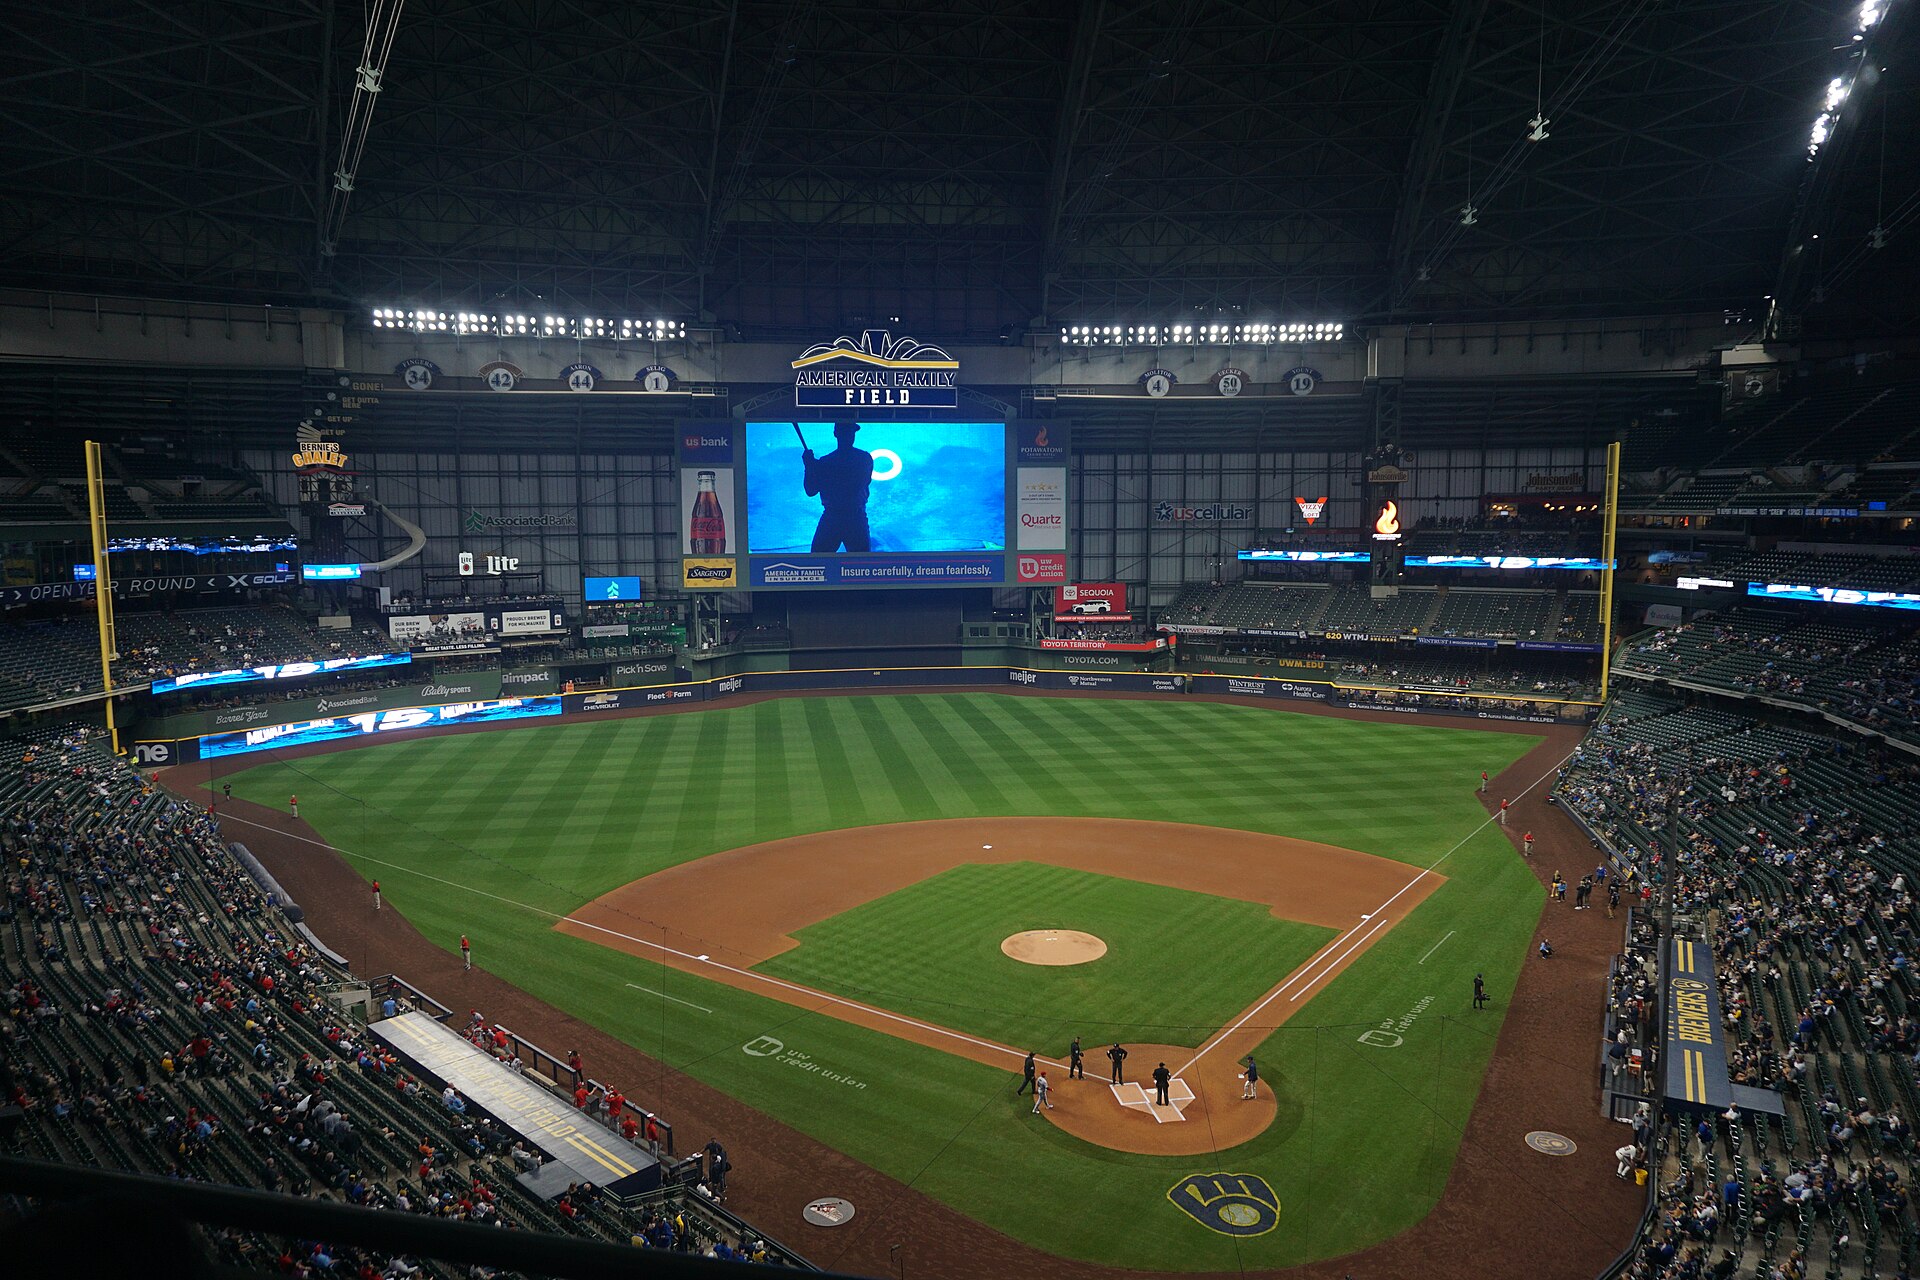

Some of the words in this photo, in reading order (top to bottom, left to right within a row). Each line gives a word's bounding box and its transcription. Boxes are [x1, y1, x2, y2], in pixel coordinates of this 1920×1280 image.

[401, 359, 434, 369] FINGERS
[408, 370, 430, 385] 34
[796, 371, 888, 387] AMERICAN
[894, 371, 956, 387] FAMILY
[1144, 369, 1172, 379] MOLITOR
[1218, 369, 1242, 377] UECKER
[352, 382, 384, 391] GONE!
[491, 373, 511, 387] 42
[571, 374, 592, 389] 44
[652, 376, 662, 390] 1
[1152, 379, 1162, 393] 4
[1223, 377, 1237, 388] 50
[1294, 377, 1312, 391] 19
[845, 389, 910, 404] FIELD
[300, 443, 339, 452] BERNIE'S
[685, 437, 699, 446] us
[700, 436, 728, 447] bank
[292, 451, 348, 467] CHALET
[1369, 471, 1407, 481] Johnsonville
[1526, 473, 1585, 486] Johnsonville
[691, 518, 723, 532] Coca-Cola
[1021, 513, 1062, 528] Quartz
[486, 555, 519, 575] Lite
[841, 566, 871, 577] Insure
[872, 565, 914, 578] carefully,
[916, 564, 944, 575] dream
[946, 563, 992, 576] fearlessly.
[253, 574, 296, 584] GOLF
[690, 568, 728, 578] SARGENTO
[30, 585, 73, 600] OPEN
[78, 580, 119, 597] YER
[131, 577, 197, 593] ROUND
[1080, 589, 1114, 597] SEQUOIA
[1343, 633, 1369, 641] WTMJ
[1418, 637, 1449, 645] WINTRUST
[1069, 641, 1106, 649] TERRITORY
[1064, 656, 1119, 665] TOYOTA.COM
[1279, 659, 1324, 669] UWM.EDU
[616, 665, 635, 674] Pick
[644, 664, 667, 673] Save
[509, 671, 549, 684] impact
[1009, 670, 1036, 684] meijer
[1228, 679, 1266, 688] WINTRUST
[421, 684, 450, 697] Bally
[450, 686, 471, 694] SPORTS
[719, 678, 743, 692] meijer
[647, 692, 665, 700] Fleet
[673, 690, 692, 698] Farm
[1292, 690, 1311, 698] Health
[1312, 691, 1326, 699] Care
[583, 702, 621, 711] CHEVROLET
[216, 713, 245, 725] Barrel
[246, 709, 268, 722] Yard
[348, 707, 434, 733] 15
[1394, 1012, 1419, 1033] credit
[1410, 995, 1436, 1014] union
[1676, 990, 1713, 1045] BREWERS
[1380, 1017, 1396, 1029] uw
[787, 1049, 811, 1060] uw
[775, 1054, 822, 1073] credit
[820, 1069, 867, 1090] union
[523, 1107, 577, 1137] FIELD
